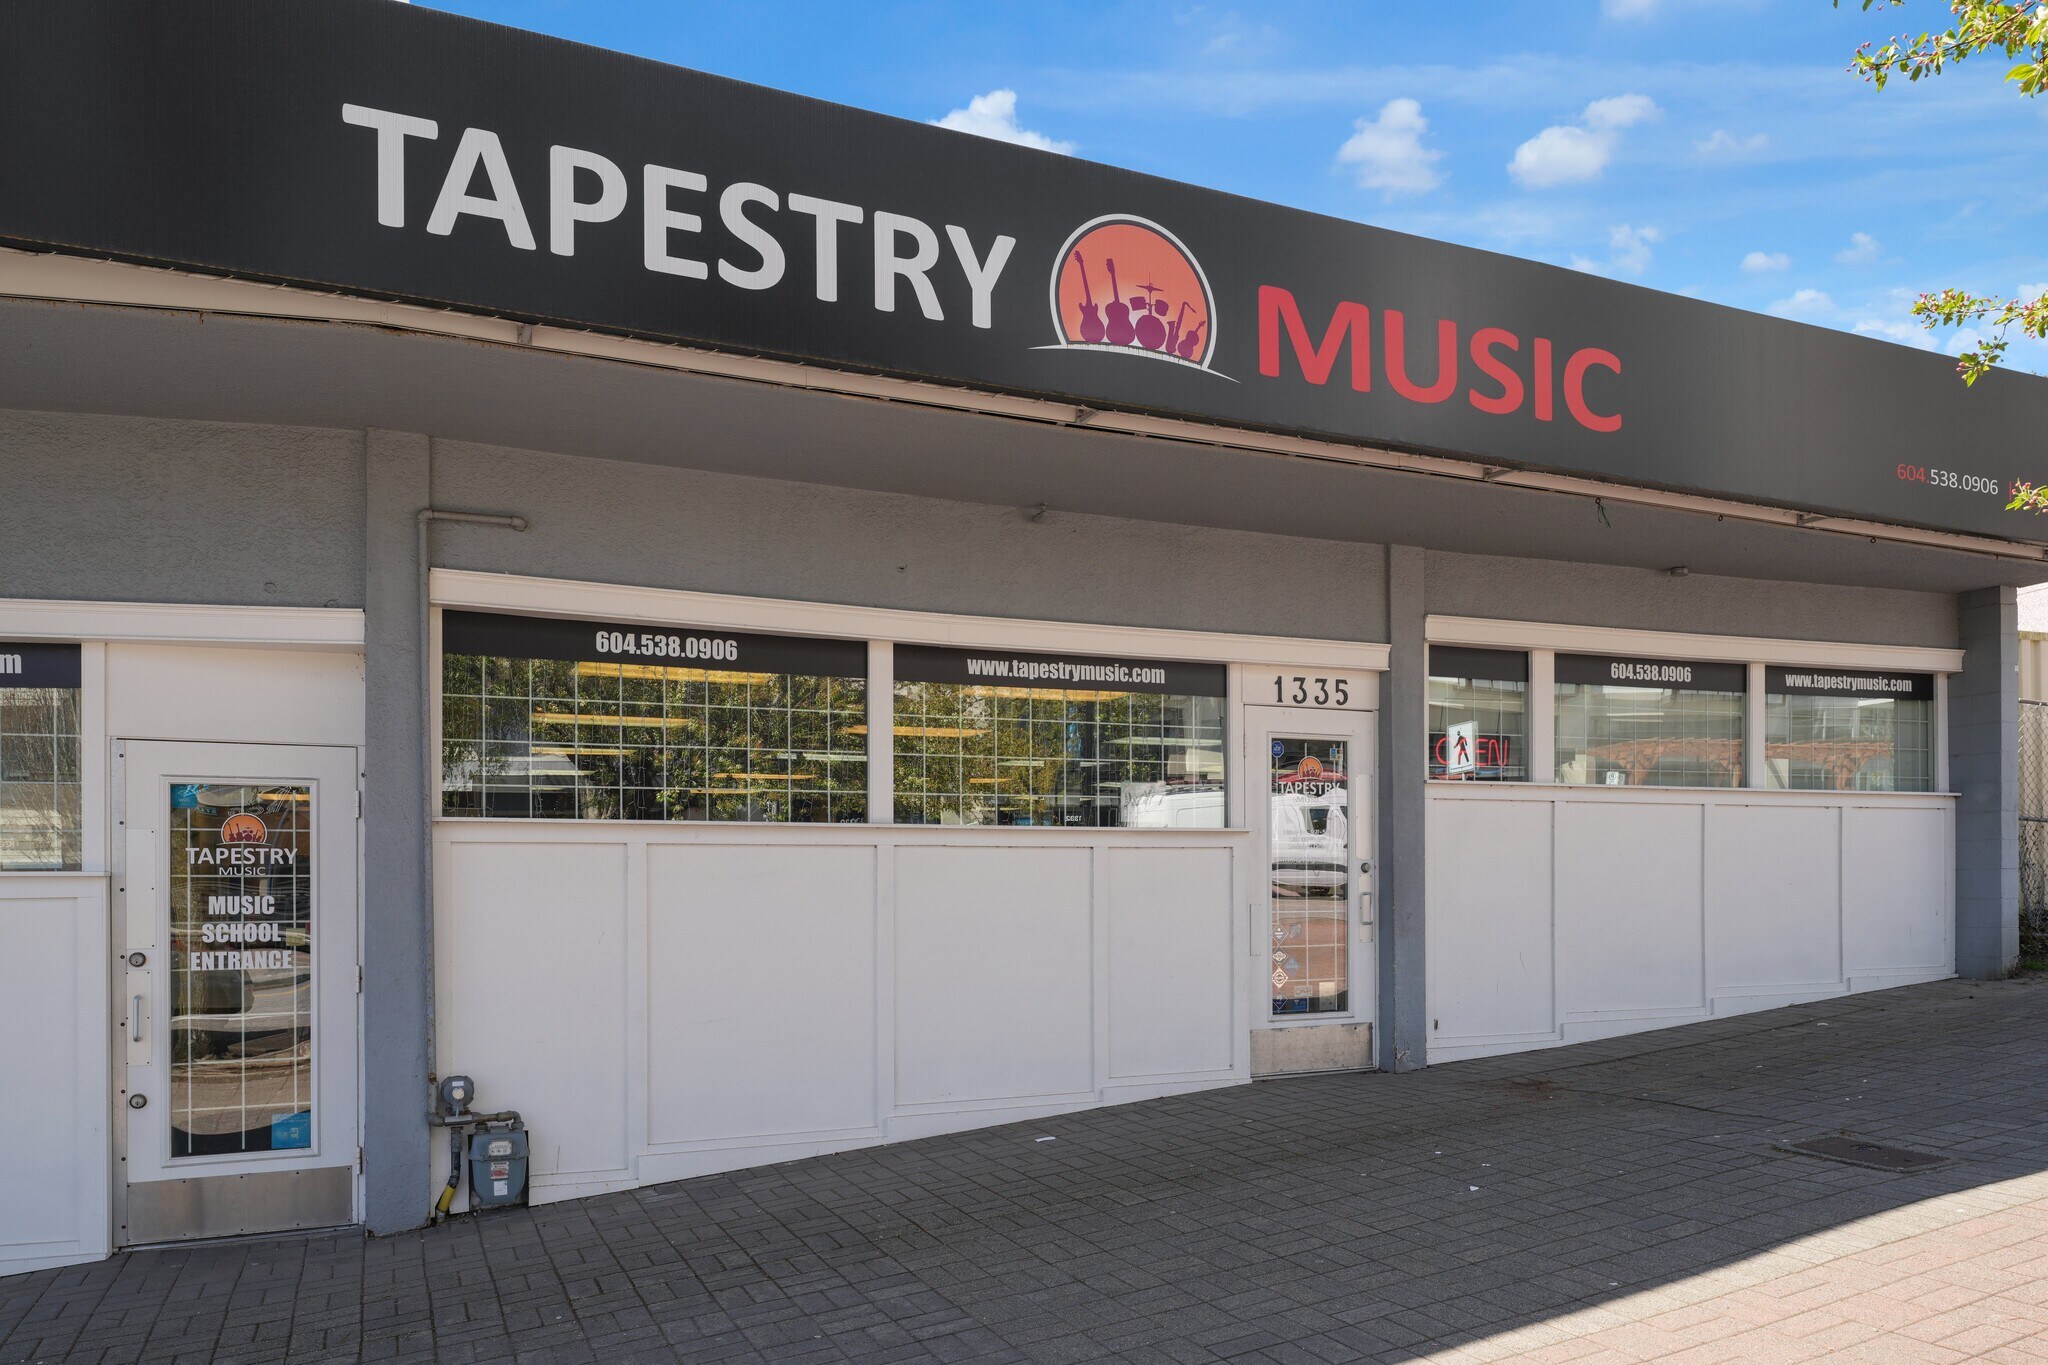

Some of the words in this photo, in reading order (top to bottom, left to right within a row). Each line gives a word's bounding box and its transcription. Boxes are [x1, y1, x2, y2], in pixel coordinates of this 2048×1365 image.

[342, 103, 1016, 328] TAPESTRY
[1258, 285, 1622, 433] MUSIC
[1897, 463, 1999, 495] 604.538.0906
[595, 631, 738, 661] 604.538.0906
[967, 659, 1166, 684] www.tapestrymusic.com
[1610, 663, 1692, 683] 604.538.0906
[1274, 676, 1349, 706] 1335
[1785, 673, 1913, 693] www.tapestrymusic.com
[1279, 781, 1341, 795] TAPESTRY
[185, 847, 298, 865] TAPESTRY
[218, 866, 266, 876] MUSIC
[208, 895, 275, 915] MUSIC
[202, 923, 282, 943] SCHOOL
[190, 950, 293, 971] ENTRANCE
